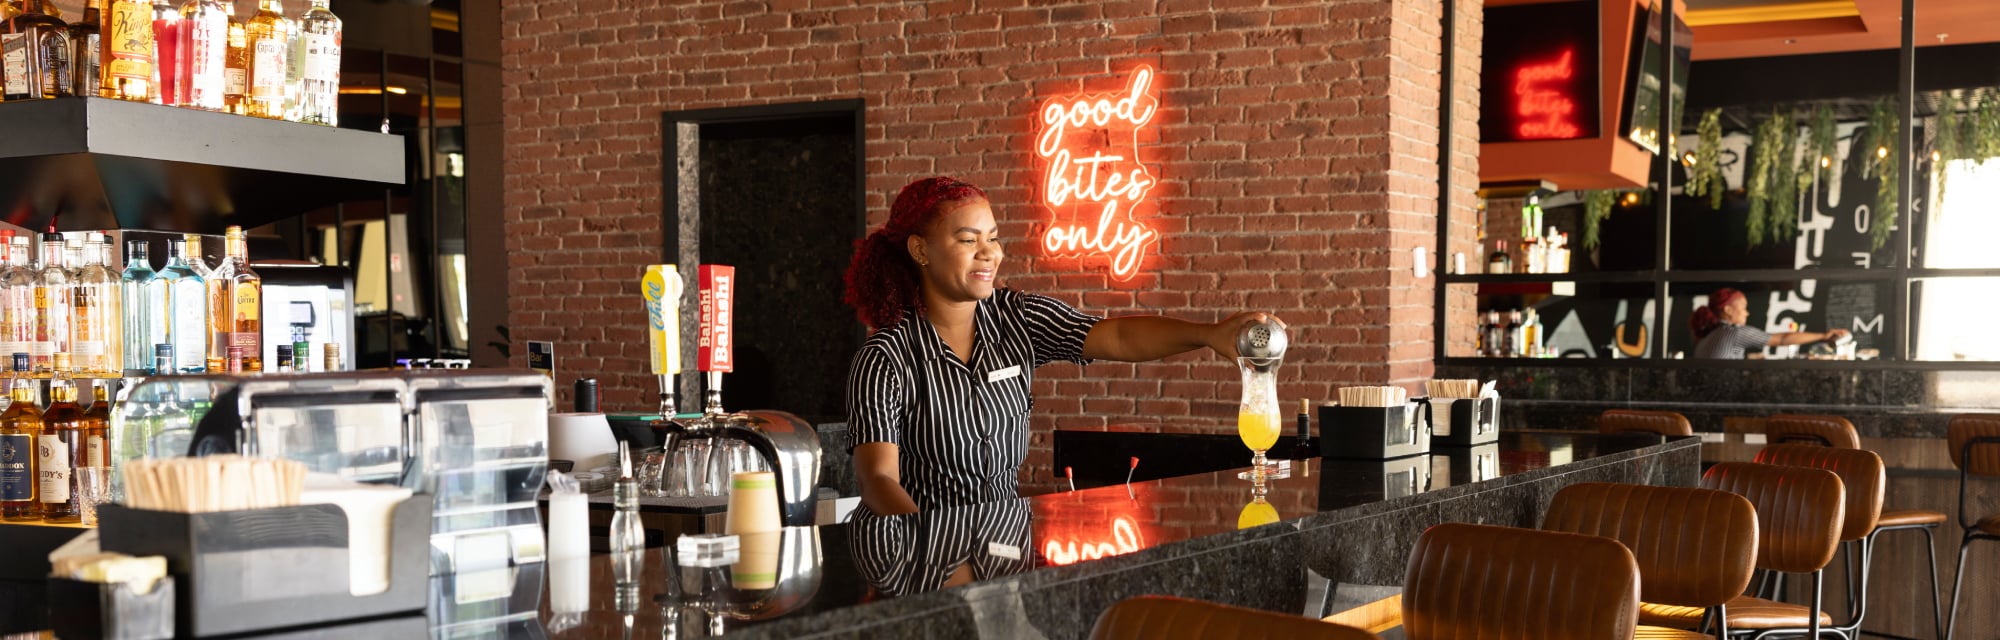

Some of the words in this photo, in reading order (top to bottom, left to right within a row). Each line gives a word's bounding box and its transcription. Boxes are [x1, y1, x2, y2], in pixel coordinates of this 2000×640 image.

[1039, 69, 1153, 157] good
[1048, 149, 1151, 207] bites
[1045, 199, 1153, 275] only
[646, 281, 666, 331] Chill
[700, 289, 711, 347] Balashi
[714, 275, 730, 363] Balashi
[530, 352, 543, 362] Bar
